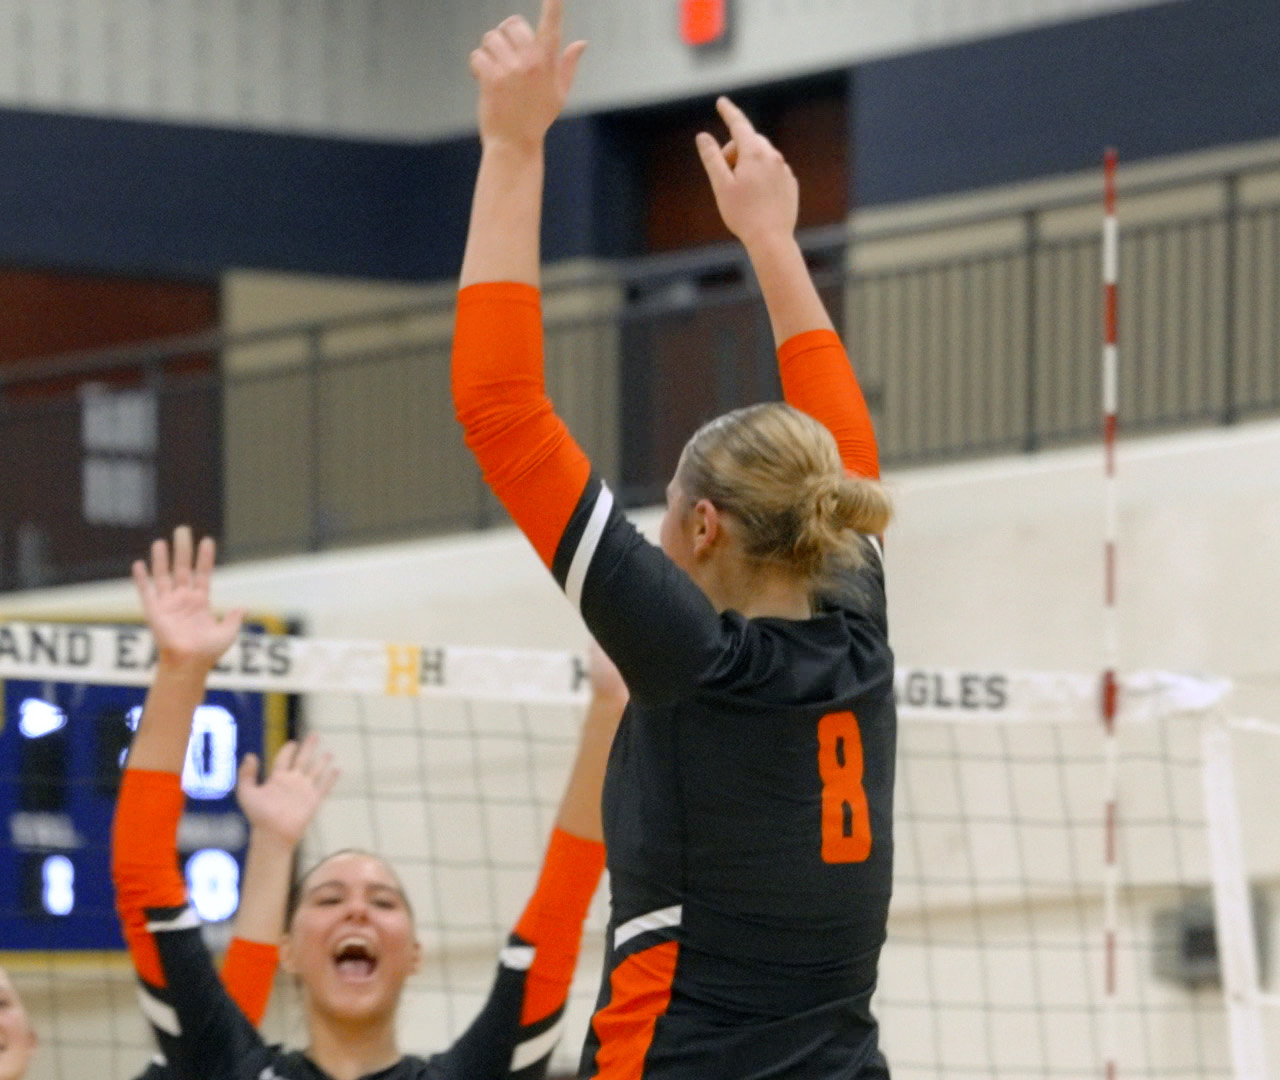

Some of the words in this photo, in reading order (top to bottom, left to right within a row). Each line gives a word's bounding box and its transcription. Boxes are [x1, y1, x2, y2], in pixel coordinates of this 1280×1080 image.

[114, 632, 291, 676] EES
[422, 647, 444, 686] H
[894, 671, 1008, 711] GLES
[817, 710, 872, 864] 8
